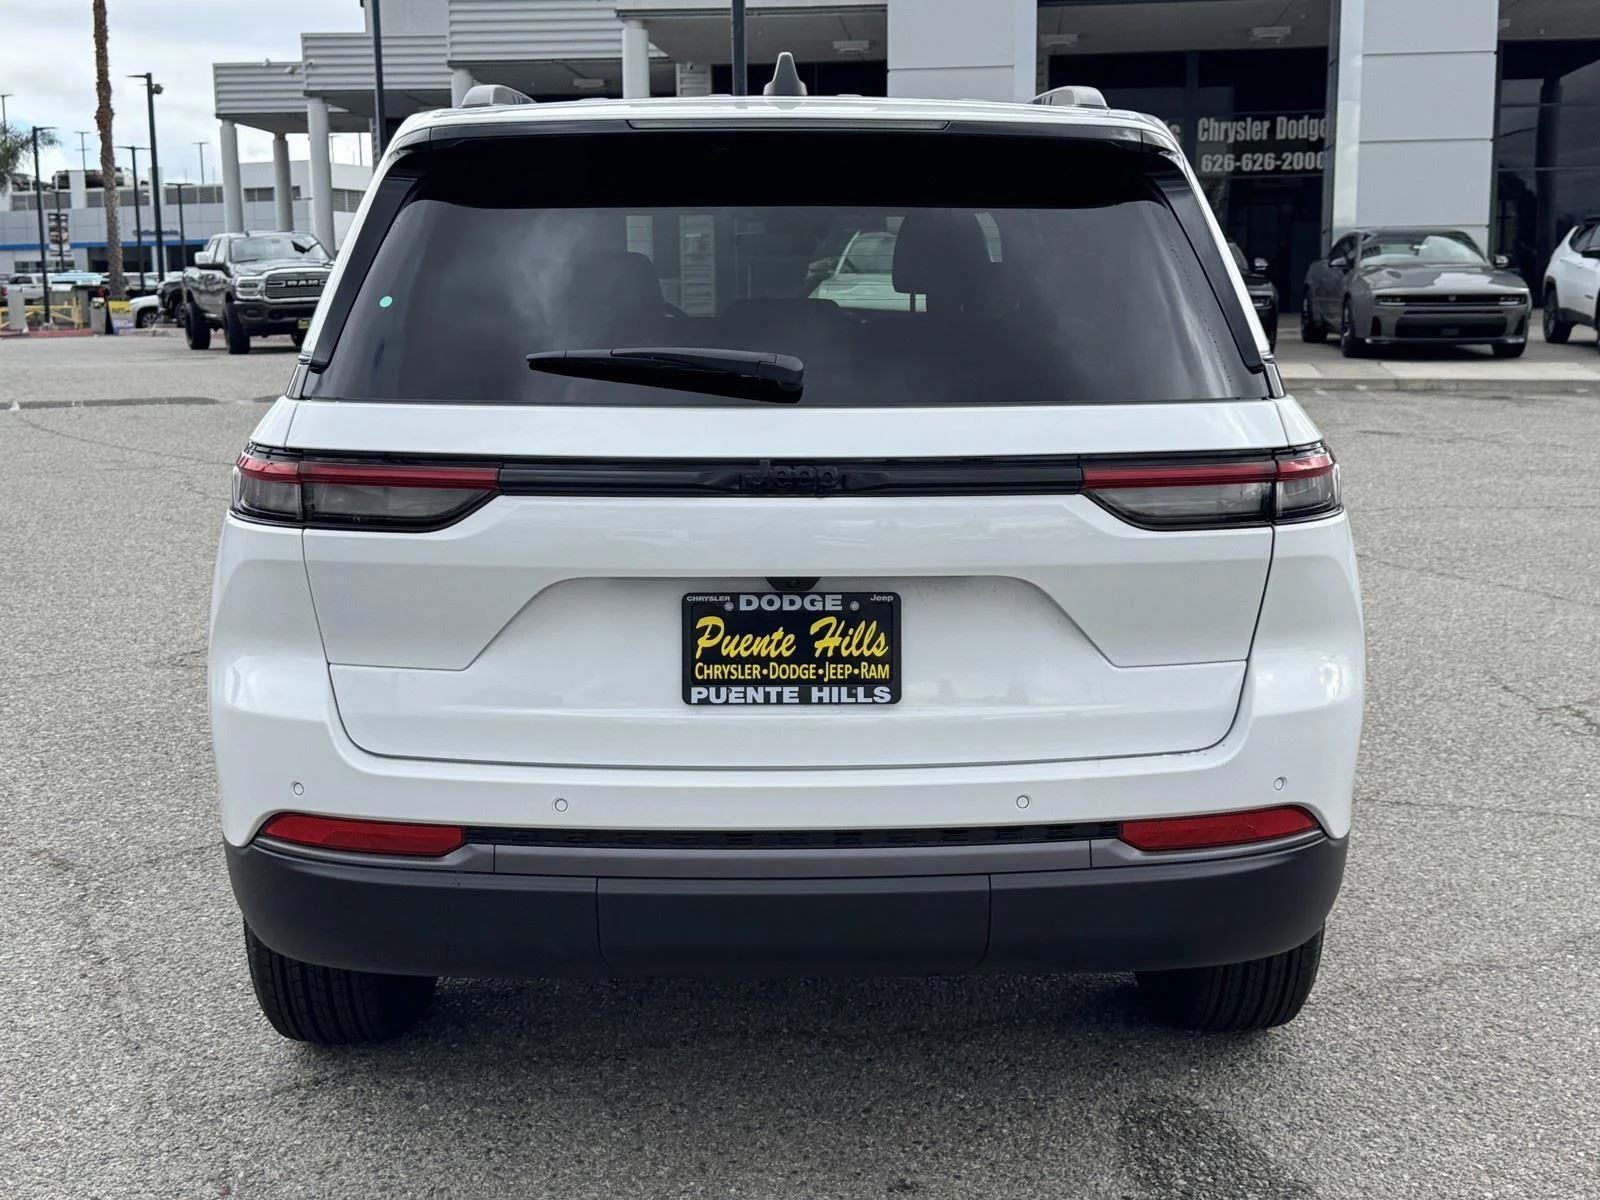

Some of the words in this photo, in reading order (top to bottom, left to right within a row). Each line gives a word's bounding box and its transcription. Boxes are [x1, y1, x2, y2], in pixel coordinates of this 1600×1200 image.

[1198, 117, 1271, 143] Chrysler
[739, 594, 843, 611] DODGE
[870, 594, 894, 602] Jeep
[695, 615, 796, 659] Puente
[810, 616, 888, 658] Hills
[690, 686, 800, 704] PUENTE
[811, 686, 892, 704] HILLS
